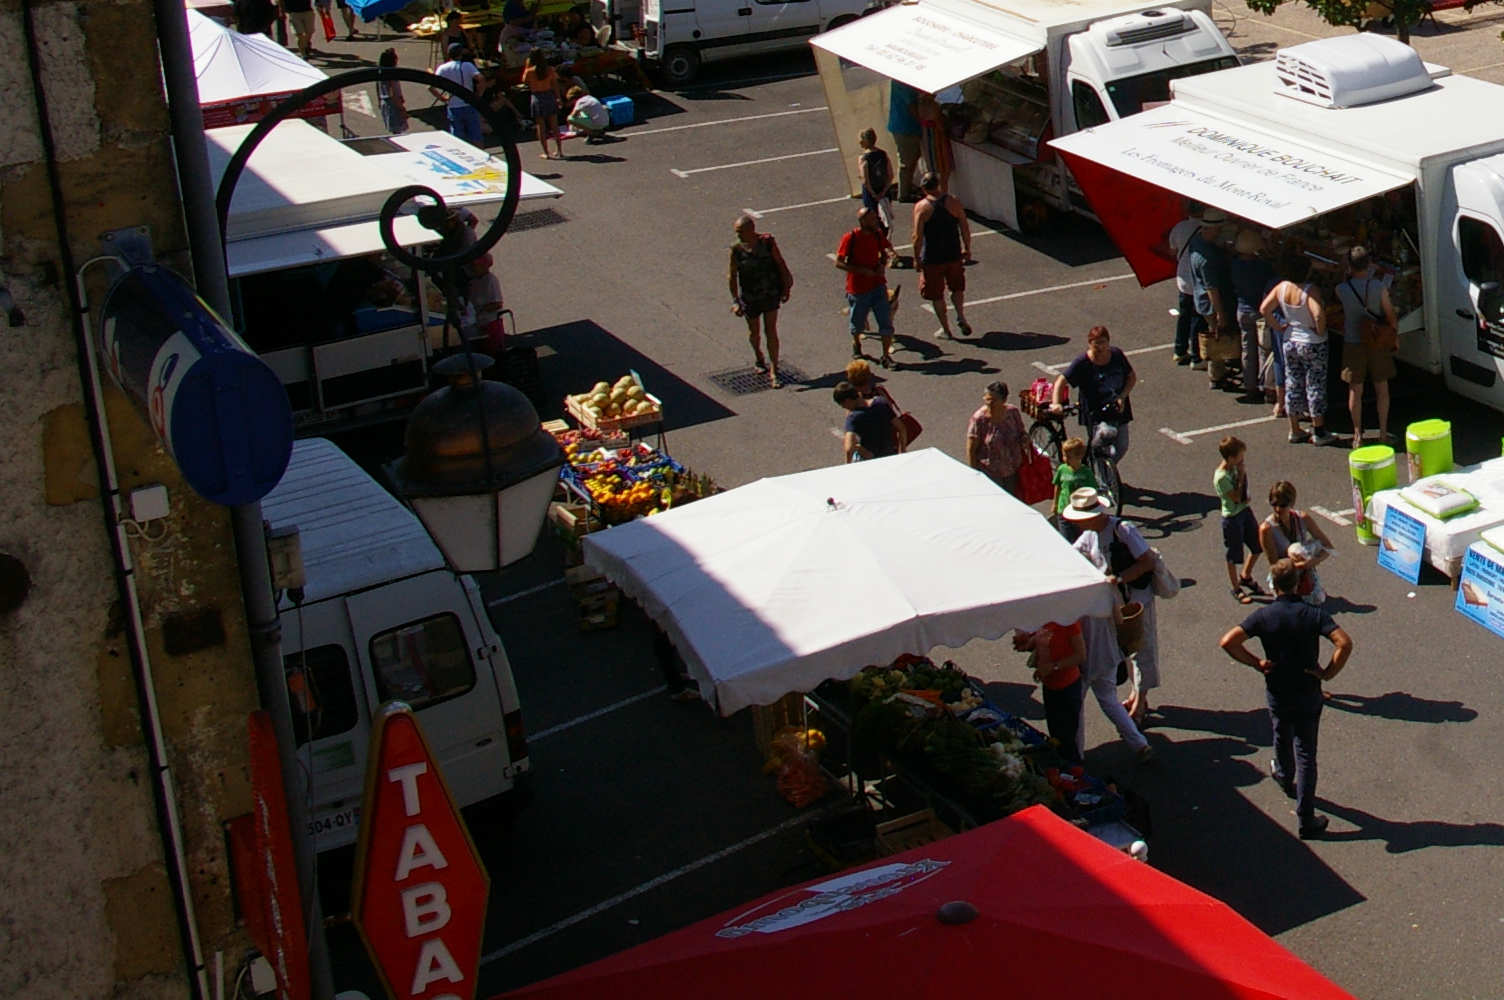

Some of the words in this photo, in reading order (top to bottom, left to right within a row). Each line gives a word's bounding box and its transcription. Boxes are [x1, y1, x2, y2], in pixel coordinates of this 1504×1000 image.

[1121, 147, 1142, 158] Les
[1140, 153, 1197, 179] Fromagers
[1196, 173, 1218, 186] du
[1186, 126, 1281, 160] DOMINIQUE
[1273, 153, 1364, 186] BOUCHAIT
[1260, 164, 1280, 178] de
[1279, 173, 1325, 193] France
[1469, 549, 1486, 566] VENTE
[1486, 558, 1494, 571] DE
[388, 761, 465, 1000] TABA
